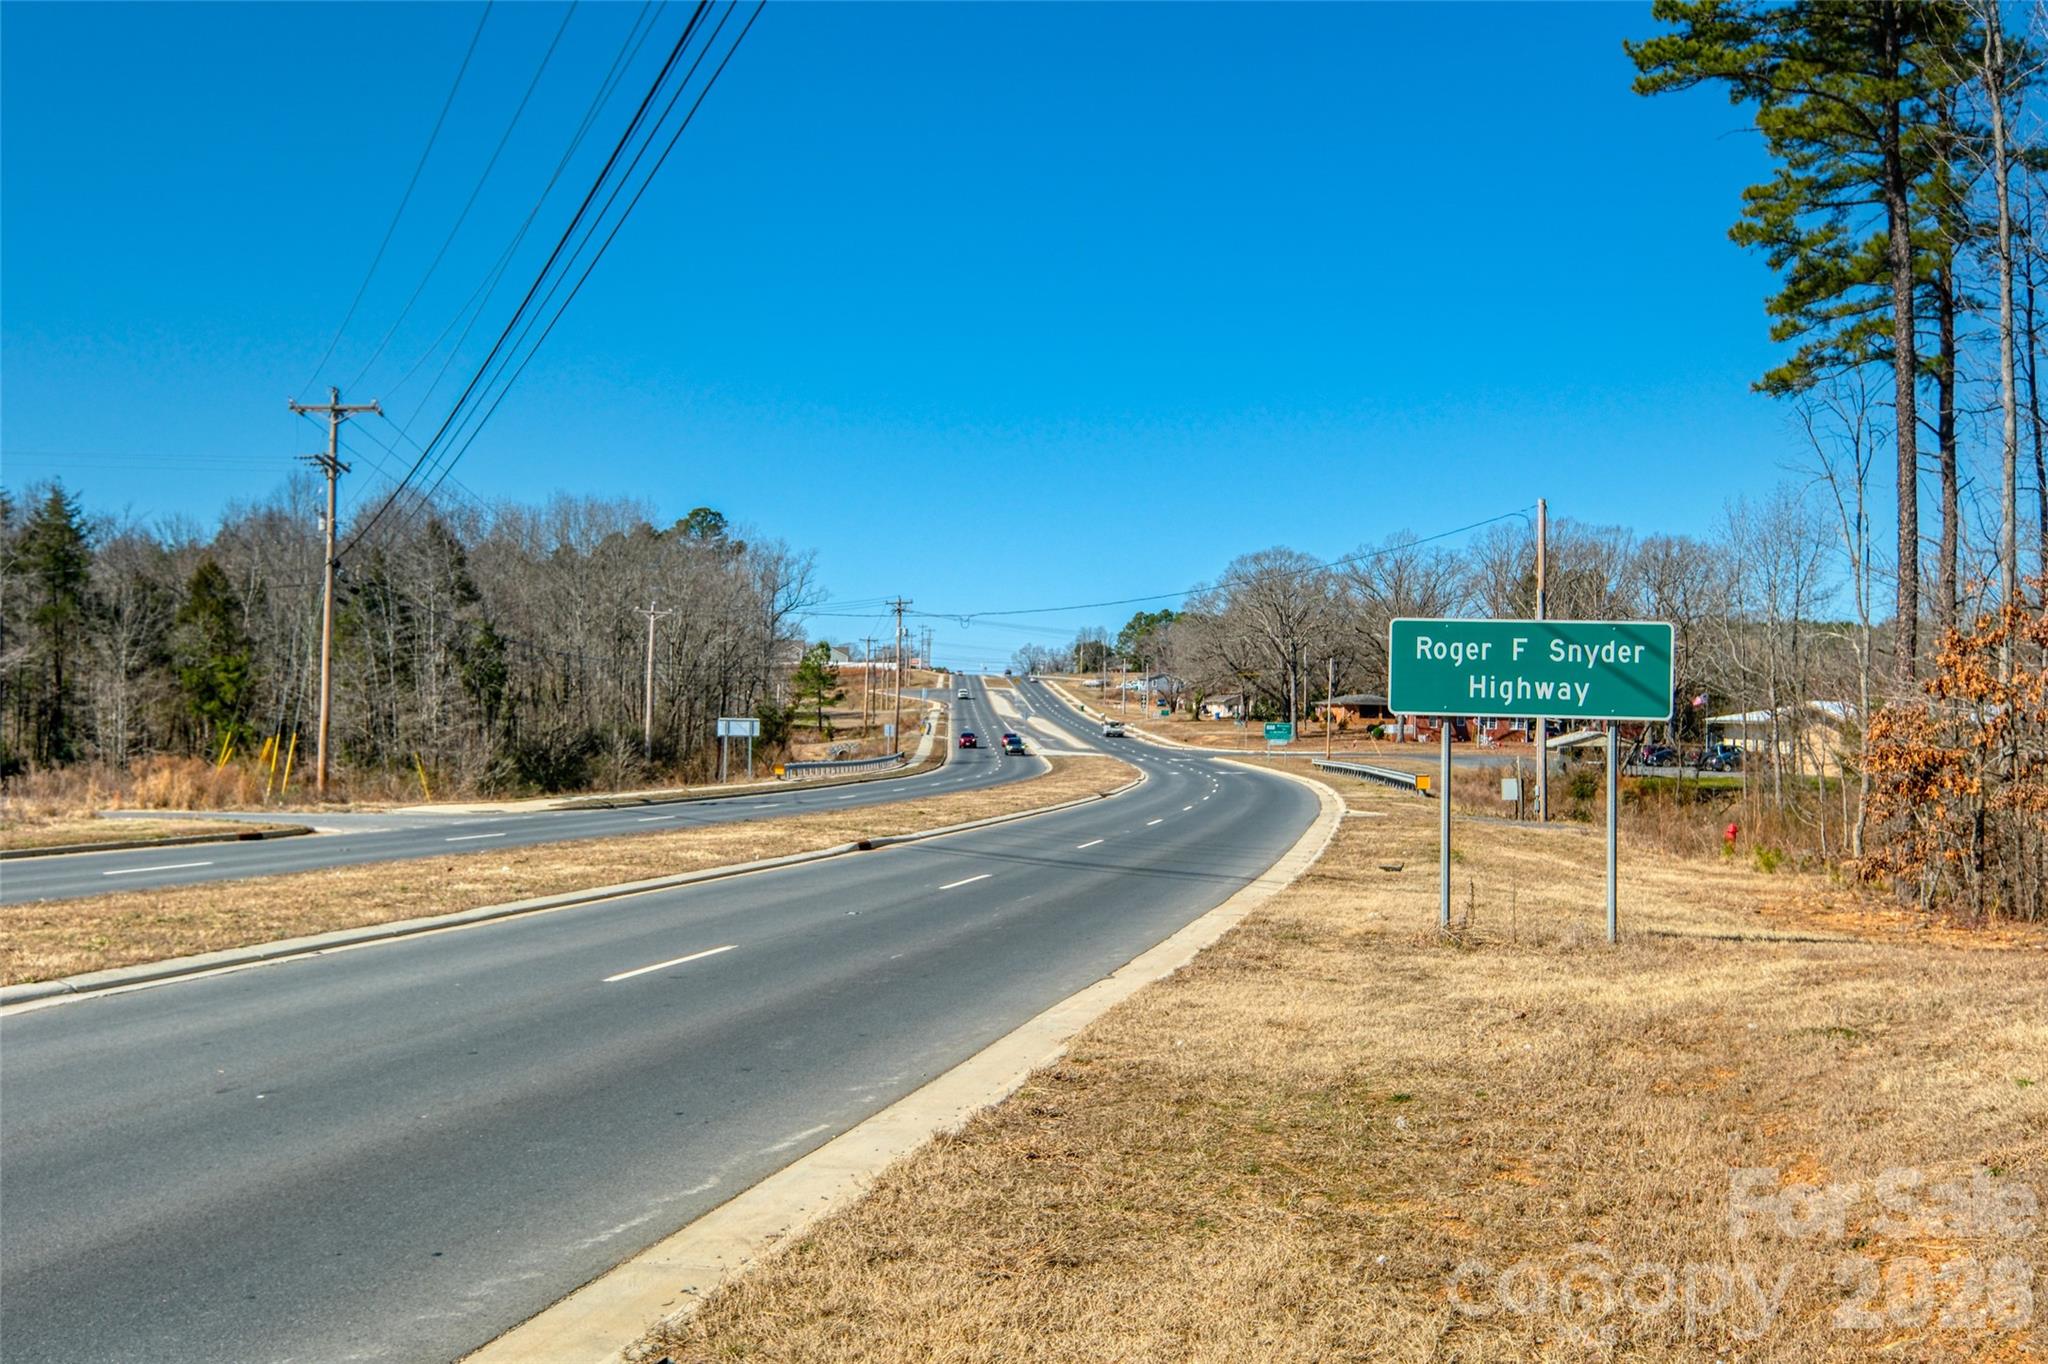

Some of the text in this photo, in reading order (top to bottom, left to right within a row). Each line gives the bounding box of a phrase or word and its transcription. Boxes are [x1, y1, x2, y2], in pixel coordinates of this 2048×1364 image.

[1416, 636, 1645, 669] Roger F Snyder
[1468, 675, 1590, 707] Highway
